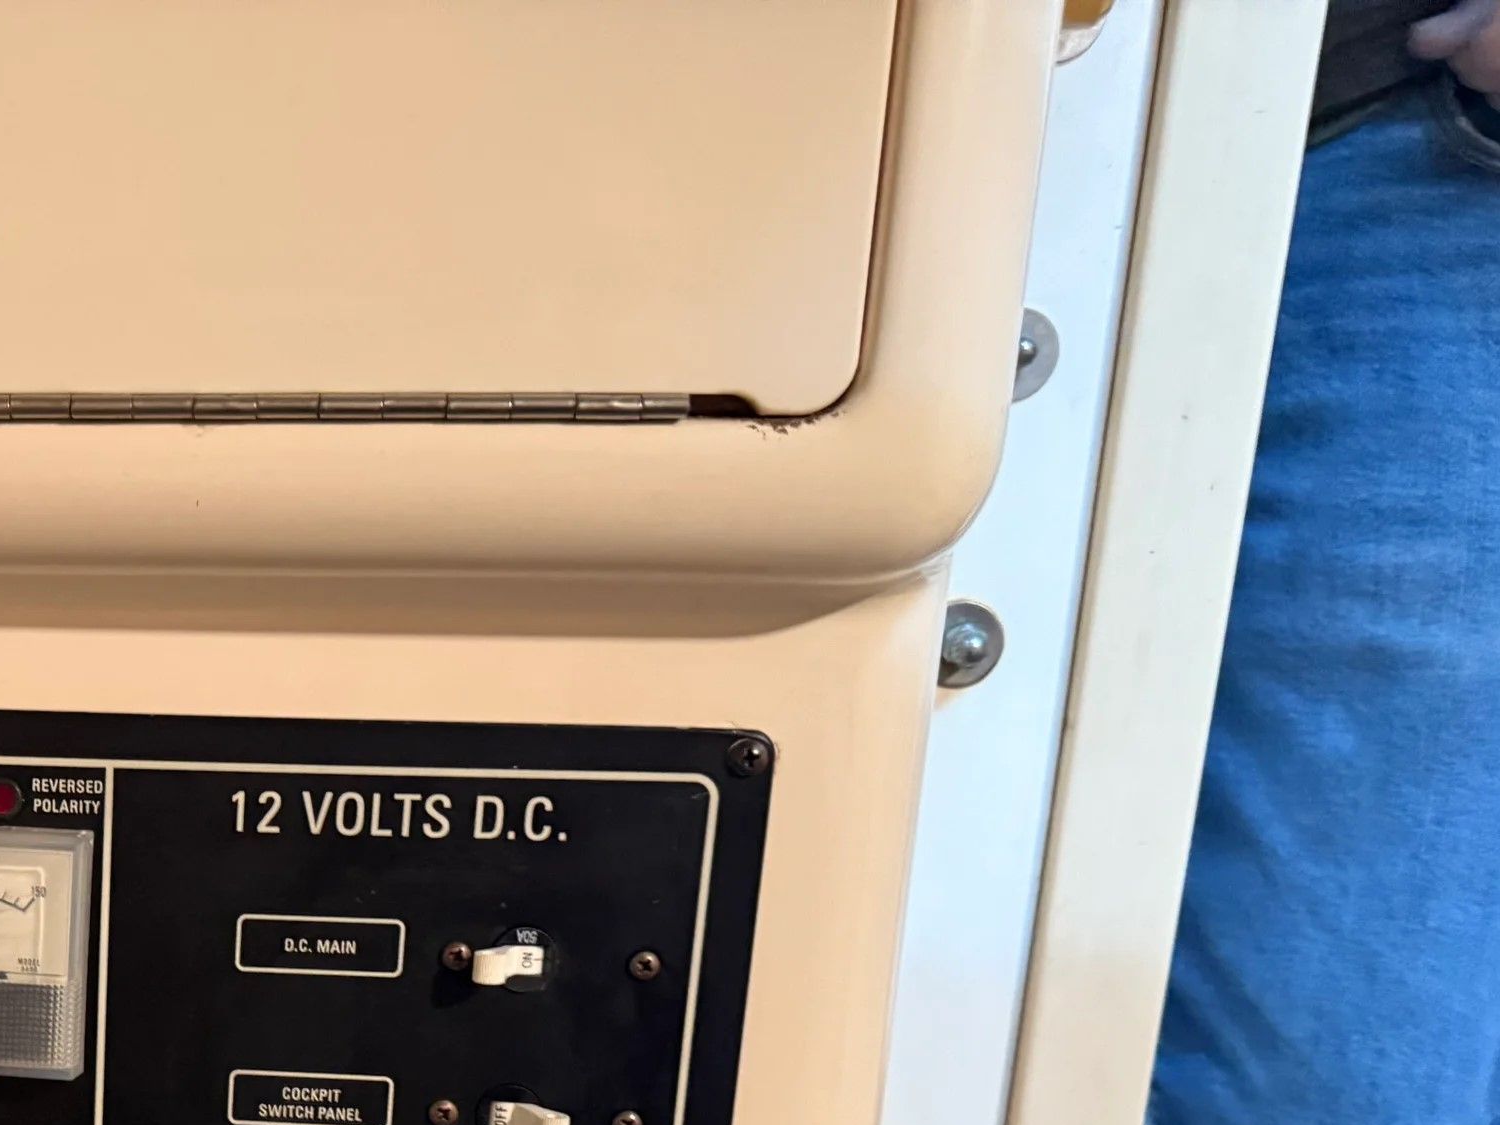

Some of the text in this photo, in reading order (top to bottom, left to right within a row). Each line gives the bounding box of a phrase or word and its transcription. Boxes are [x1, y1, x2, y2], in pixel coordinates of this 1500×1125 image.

[32, 778, 104, 794] REVERSED
[33, 798, 101, 815] POLARITY
[231, 790, 568, 842] 12 VOLTS D.C.
[31, 886, 47, 898] 150
[284, 938, 357, 955] D.C. MAIN
[522, 951, 534, 969] ON
[282, 1087, 341, 1103] COCKPIT
[258, 1103, 362, 1122] SWITCH PANEL
